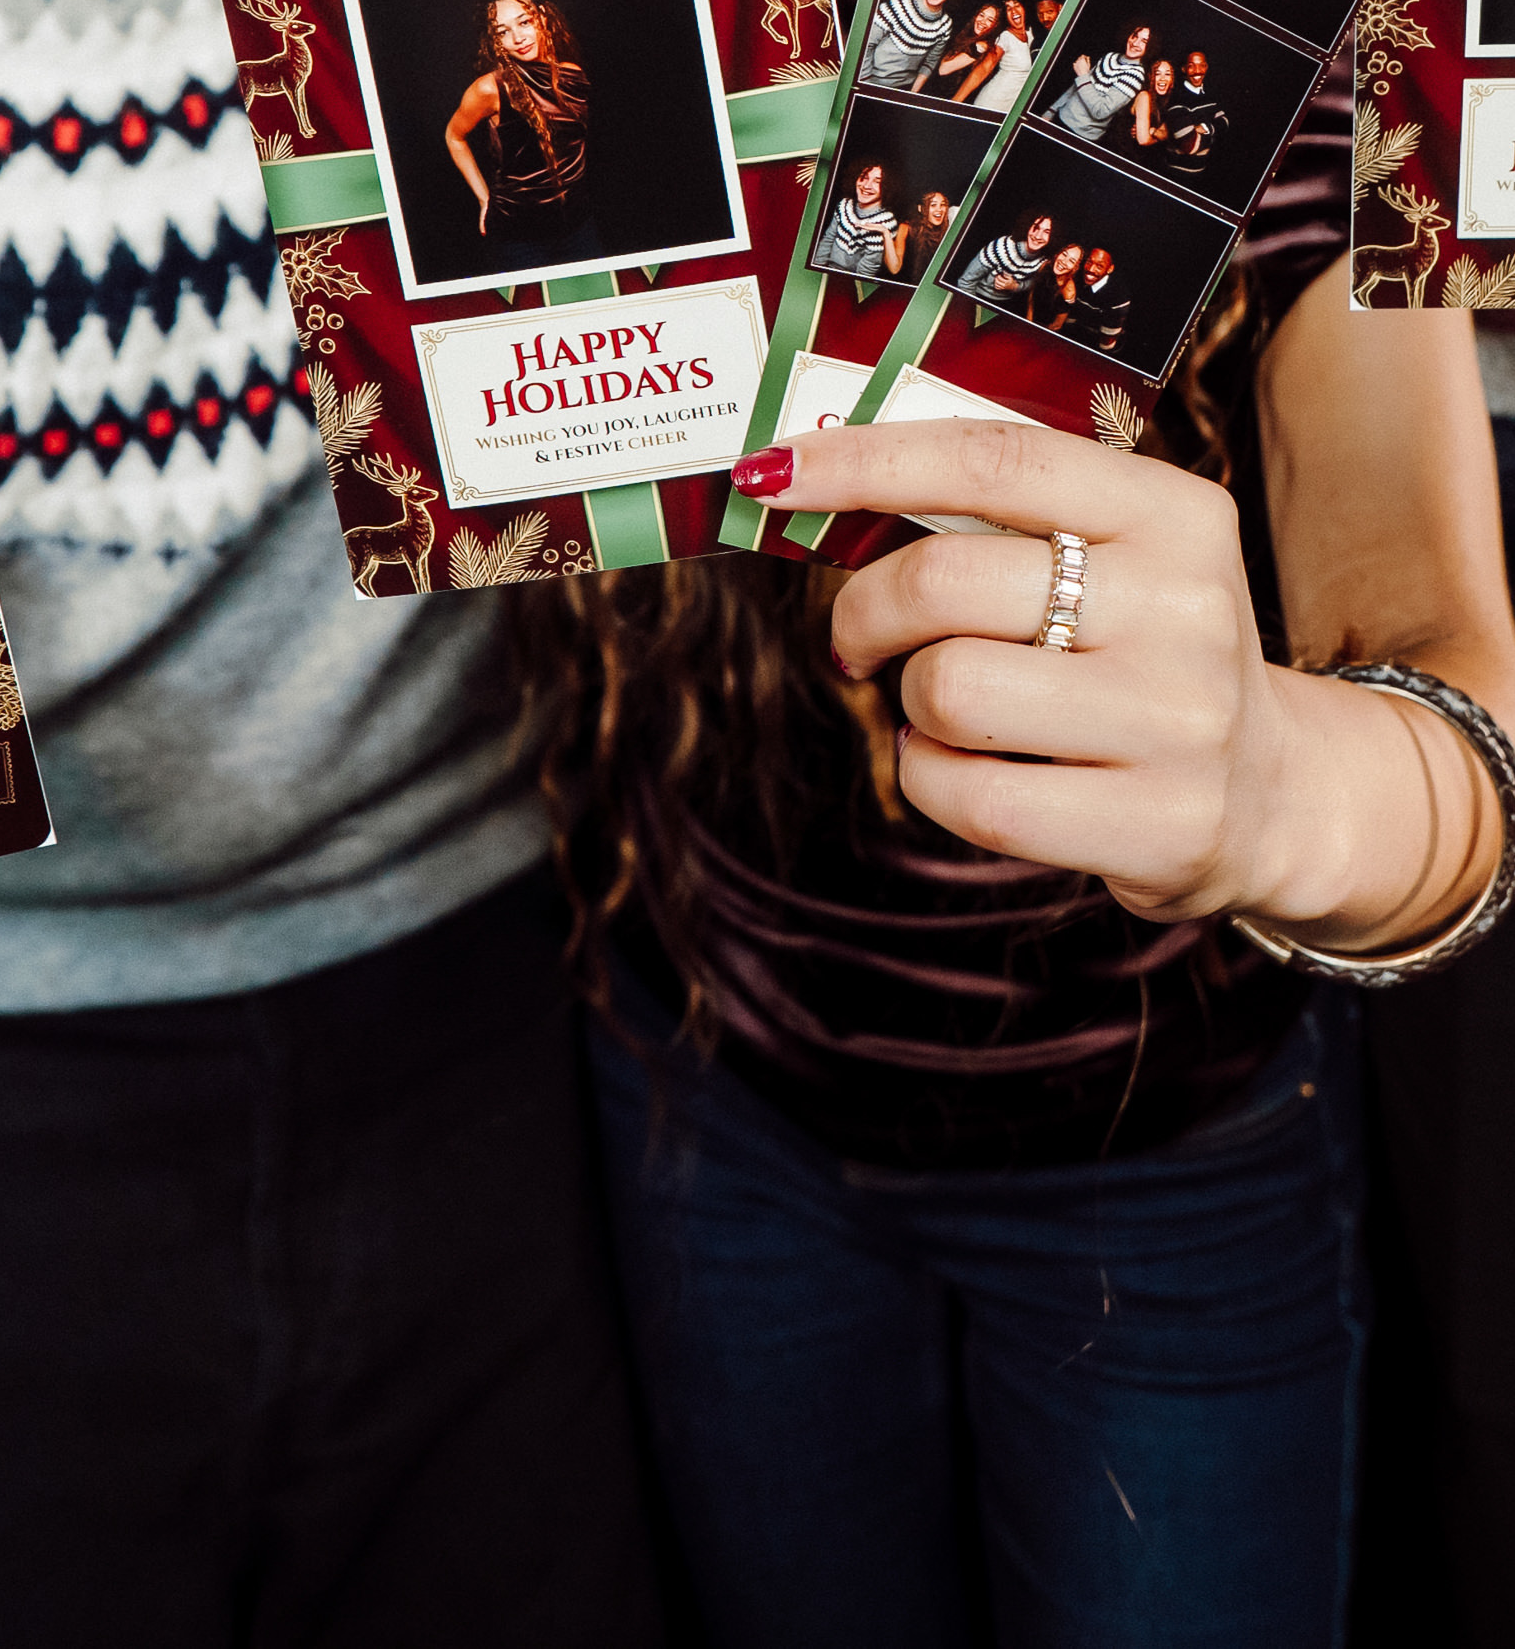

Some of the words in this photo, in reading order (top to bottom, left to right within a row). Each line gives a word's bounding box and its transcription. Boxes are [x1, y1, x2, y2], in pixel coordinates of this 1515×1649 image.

[510, 321, 666, 380] HAPPY
[480, 357, 714, 426] HOLIDAYS
[475, 429, 556, 451] WISHING
[561, 423, 599, 439] YOU
[603, 418, 640, 436] JOY,
[643, 402, 739, 427] LAUGHTER
[535, 451, 550, 463] &
[554, 439, 625, 461] FESTIVE
[628, 430, 687, 450] CHEER
